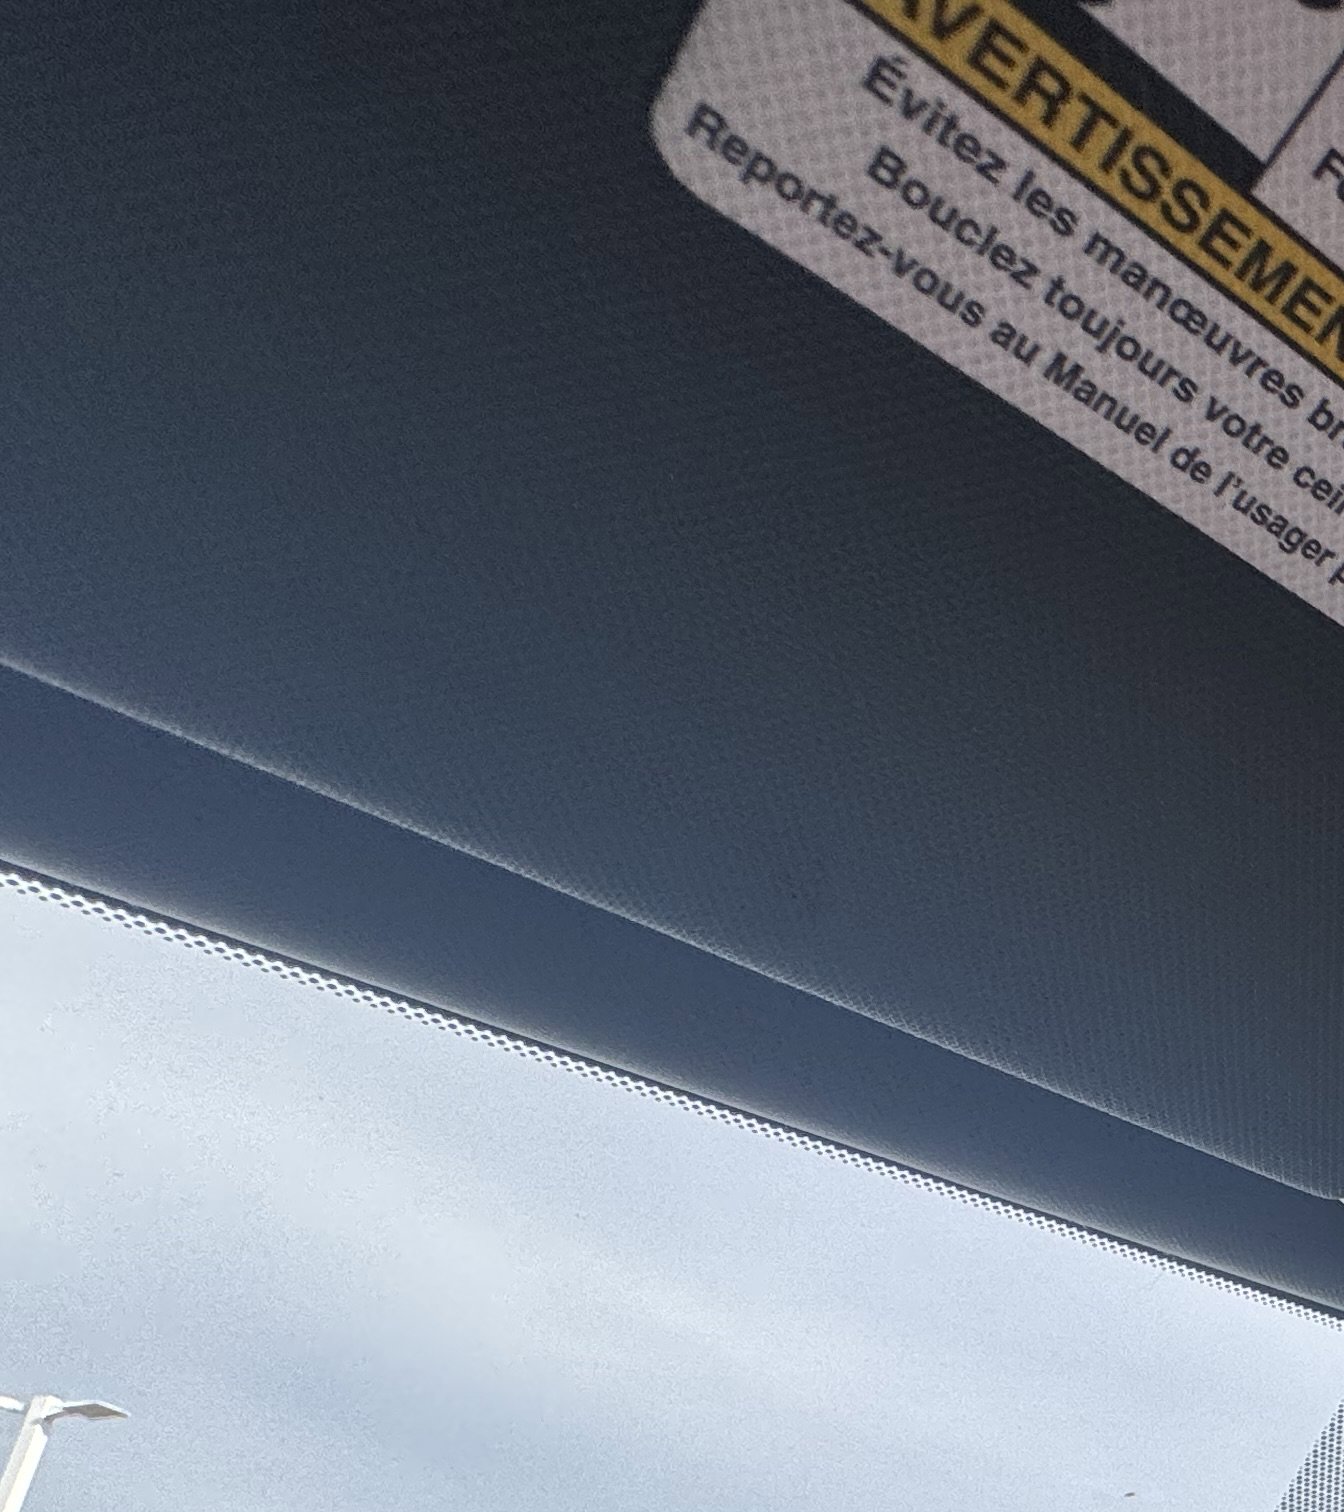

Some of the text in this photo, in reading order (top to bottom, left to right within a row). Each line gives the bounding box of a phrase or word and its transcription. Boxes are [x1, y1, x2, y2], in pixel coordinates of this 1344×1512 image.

[685, 102, 986, 328] Reportez-vous
[990, 321, 1041, 366] au
[1043, 351, 1172, 453] Manuel
[1170, 447, 1212, 484] de
[861, 54, 1008, 186] Évitez
[1012, 172, 1078, 237] les
[866, 145, 1040, 290] Bouclez
[1044, 276, 1199, 404] toujours
[1205, 396, 1289, 470] votre
